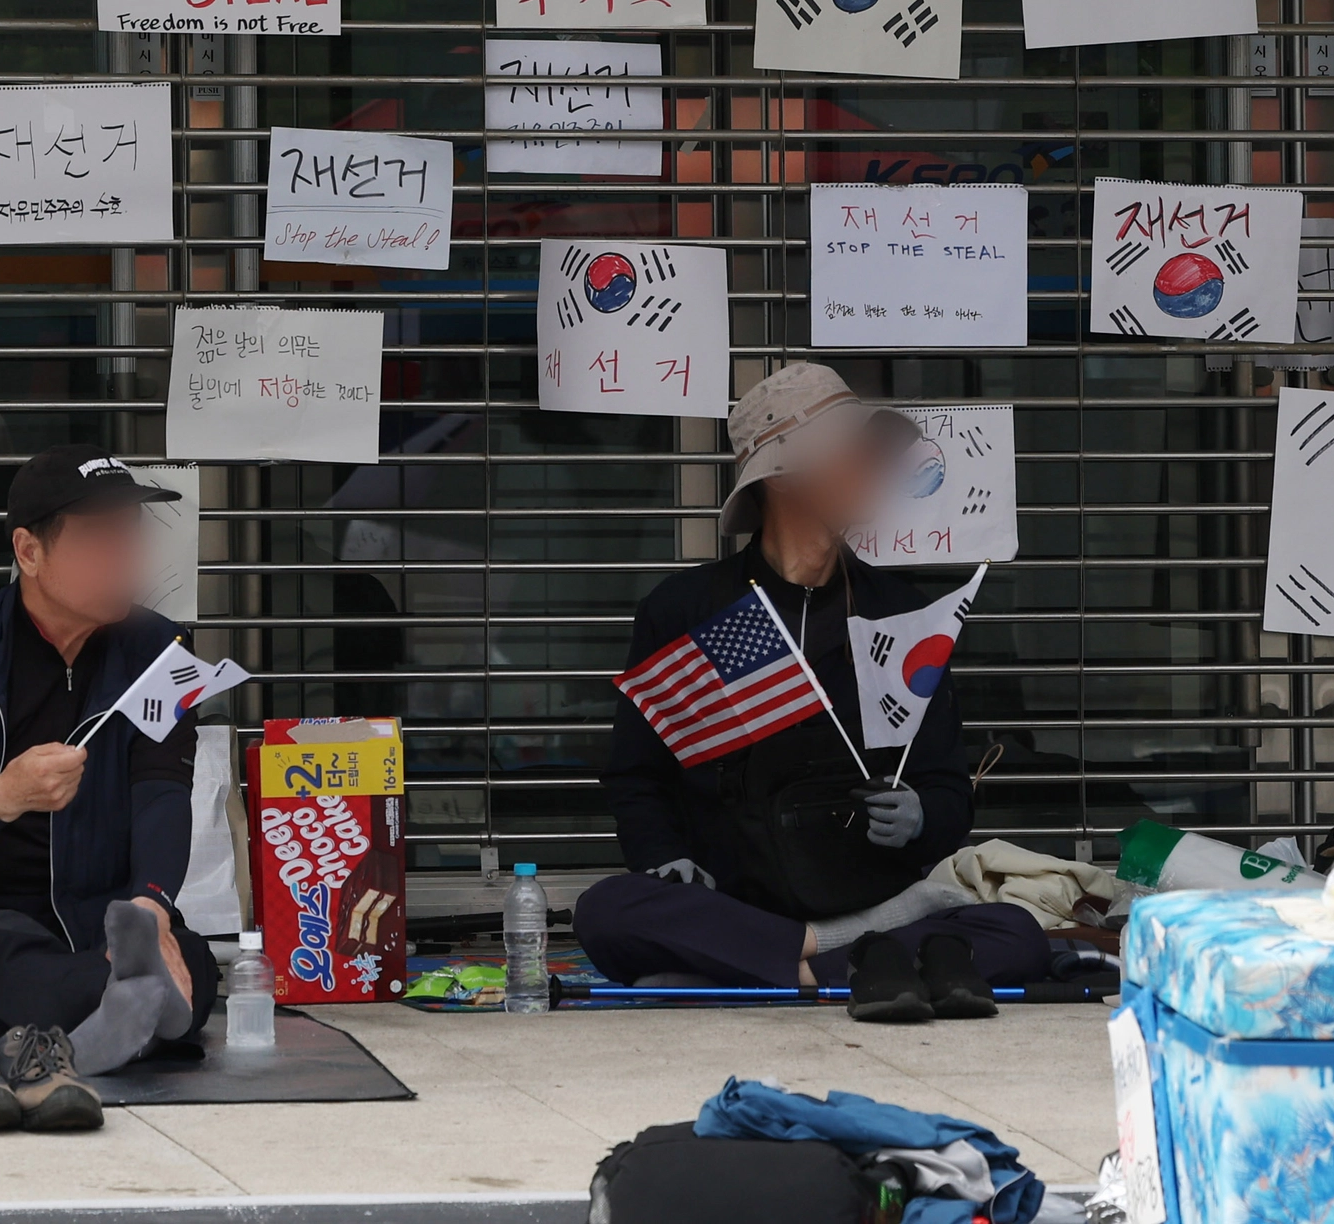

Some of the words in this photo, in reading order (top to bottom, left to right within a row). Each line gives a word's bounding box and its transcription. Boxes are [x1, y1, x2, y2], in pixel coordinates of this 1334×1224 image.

[117, 13, 204, 31] Freedom
[214, 16, 228, 31] is
[237, 15, 268, 32] not
[276, 15, 324, 34] Free
[280, 148, 429, 204] 재선거
[325, 226, 359, 248] the
[841, 206, 978, 239] 재선거
[1114, 196, 1250, 249] 재선거
[827, 241, 871, 255] STOP
[887, 244, 924, 257] THE
[944, 246, 1006, 259] STEAL
[191, 326, 228, 364] 젊은
[278, 336, 320, 359] 의무는
[189, 373, 242, 410] 불의에
[258, 374, 326, 408] 저항하는
[335, 383, 374, 402] 것이다
[544, 349, 692, 397] 재선거
[847, 527, 952, 557] 재선거
[347, 752, 359, 787] 드립니다
[261, 808, 313, 887] Deep
[290, 882, 335, 992] 오예스
